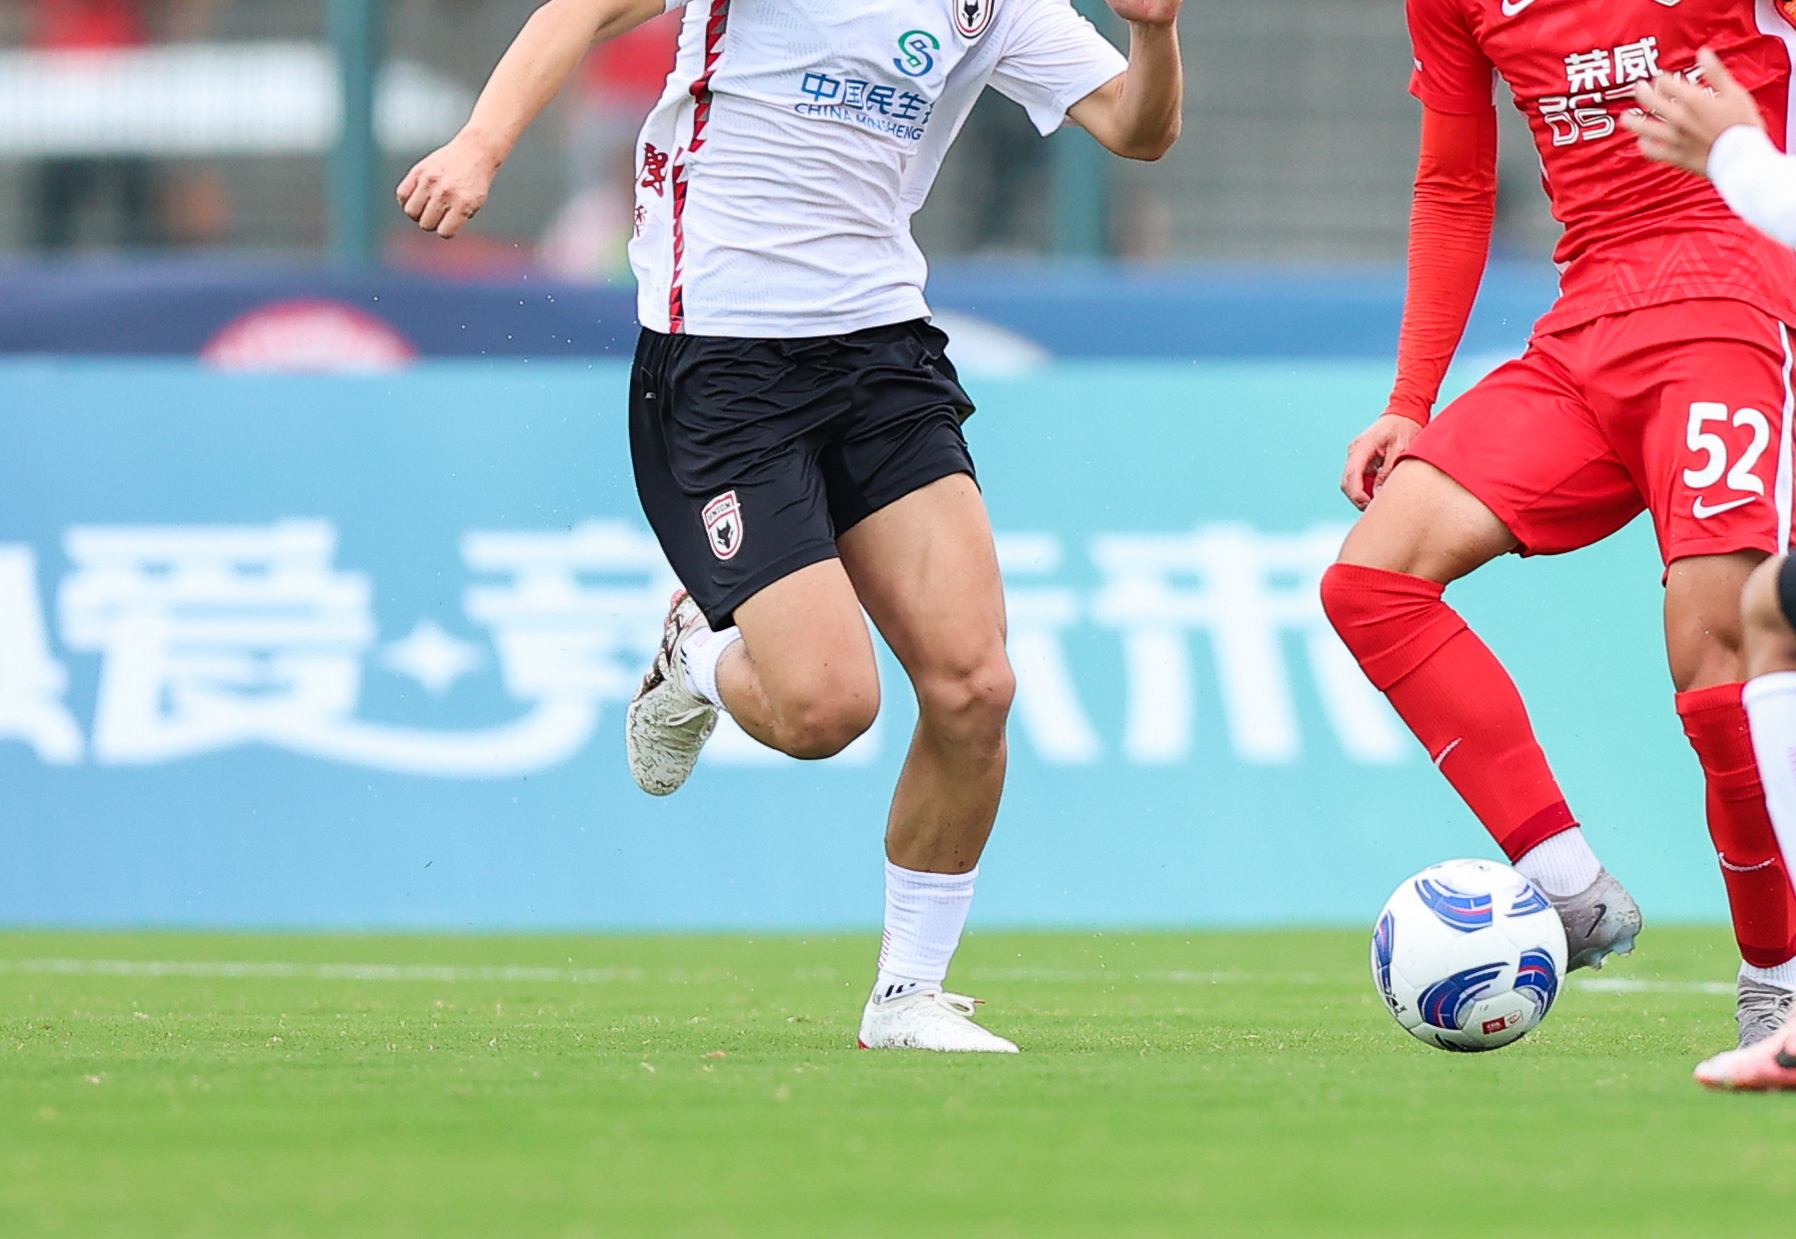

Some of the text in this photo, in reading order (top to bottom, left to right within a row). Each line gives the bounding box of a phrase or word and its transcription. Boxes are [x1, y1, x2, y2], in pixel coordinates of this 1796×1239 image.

[1564, 36, 1664, 93] 荣威
[794, 102, 853, 122] CHINA
[1680, 402, 1771, 496] 52
[708, 502, 731, 521] UNION
